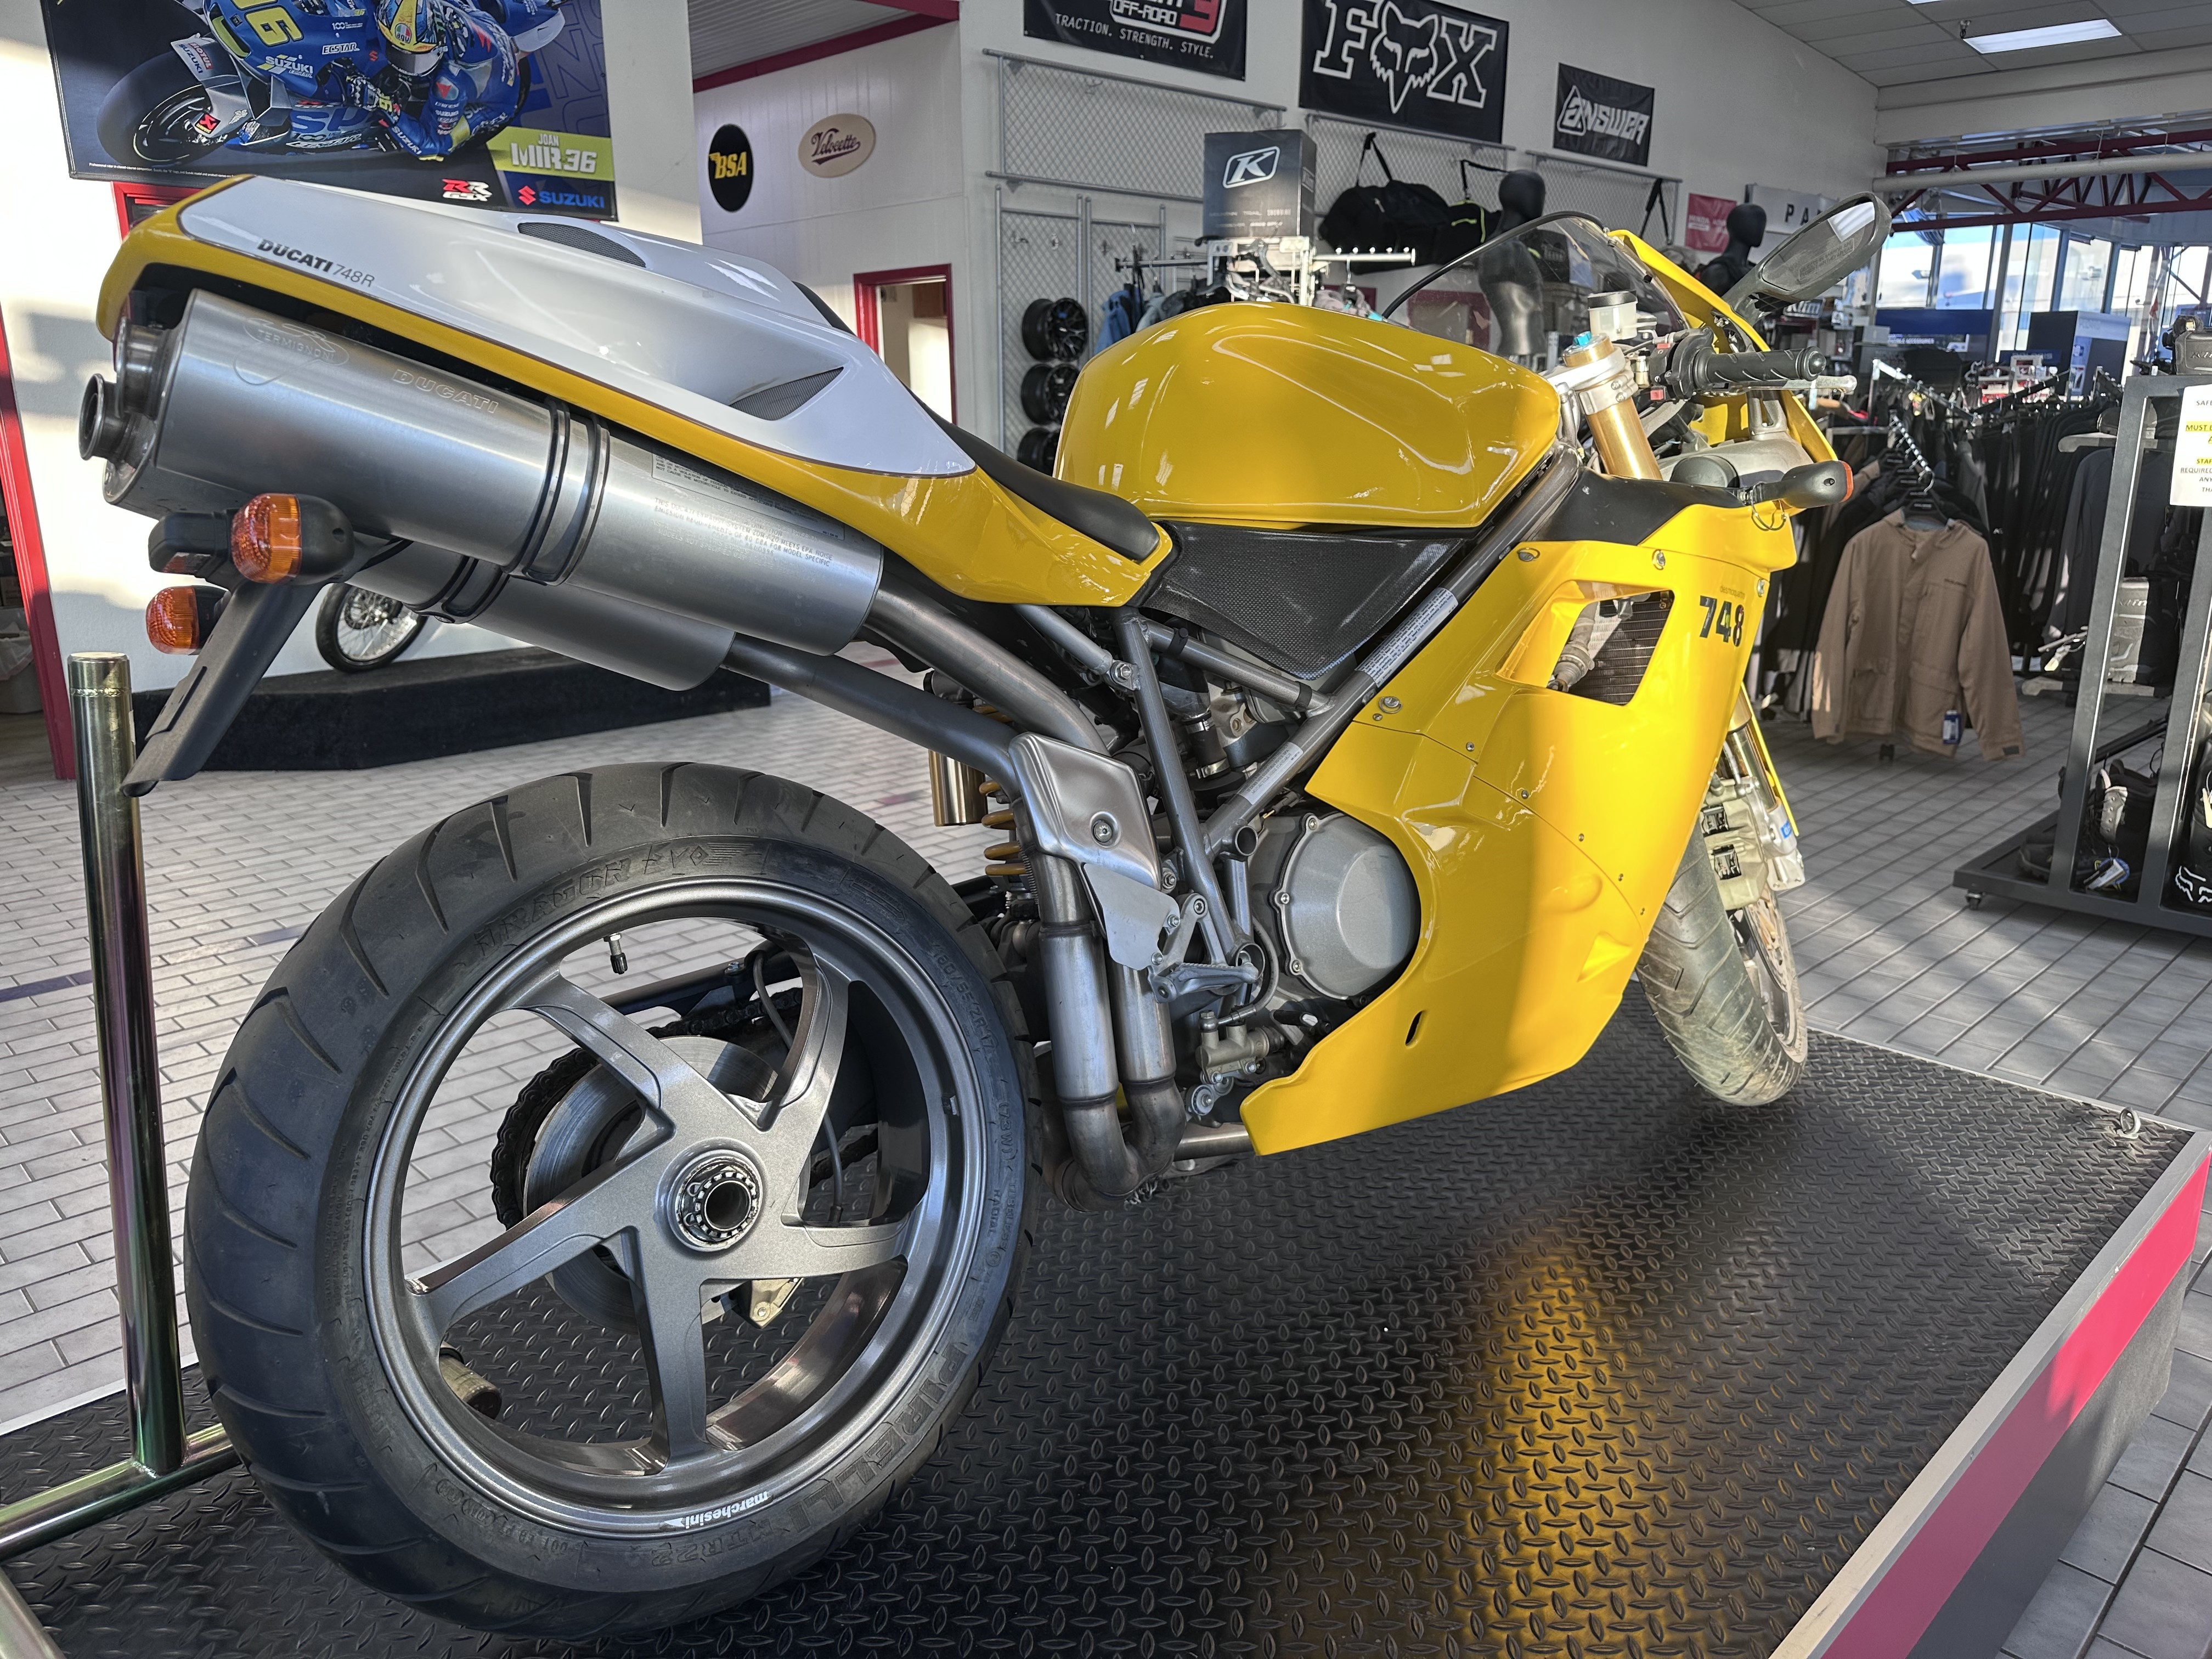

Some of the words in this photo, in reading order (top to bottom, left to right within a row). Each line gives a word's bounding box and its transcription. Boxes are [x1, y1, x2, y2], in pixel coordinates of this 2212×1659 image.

[1113, 0, 1177, 26] OFF-ROAD
[322, 43, 360, 54] ECSTAR
[1056, 14, 1113, 37] TRACTION.
[1119, 28, 1173, 50] STRENGTH.
[1181, 41, 1214, 59] STYLE.
[178, 44, 203, 74] SUZUKI
[189, 42, 214, 70] MOTUL
[266, 56, 313, 74] SUZUKI
[391, 126, 422, 155] SUZUKI
[538, 133, 560, 147] JOAN
[810, 128, 861, 157] Velocette
[714, 151, 748, 179] BSA
[539, 191, 605, 208] SUZUKI
[1785, 204, 1823, 225] PA
[257, 239, 335, 273] DUCATI
[332, 263, 376, 288] 748R
[258, 329, 336, 362] TERMIGNONI
[392, 368, 500, 414] DUCATI
[769, 542, 782, 551] FOR
[782, 546, 803, 558] MODEL
[804, 553, 831, 567] SPECIFIC
[780, 538, 800, 549] MEETS
[801, 545, 813, 554] EPA
[814, 549, 833, 560] NOISE
[1699, 595, 1745, 647] 748
[986, 1189, 1001, 1237] RADIAL
[997, 1181, 1016, 1251] TUBELESS
[787, 1343, 968, 1533] PIRELLI
[686, 1491, 769, 1530] marchesini
